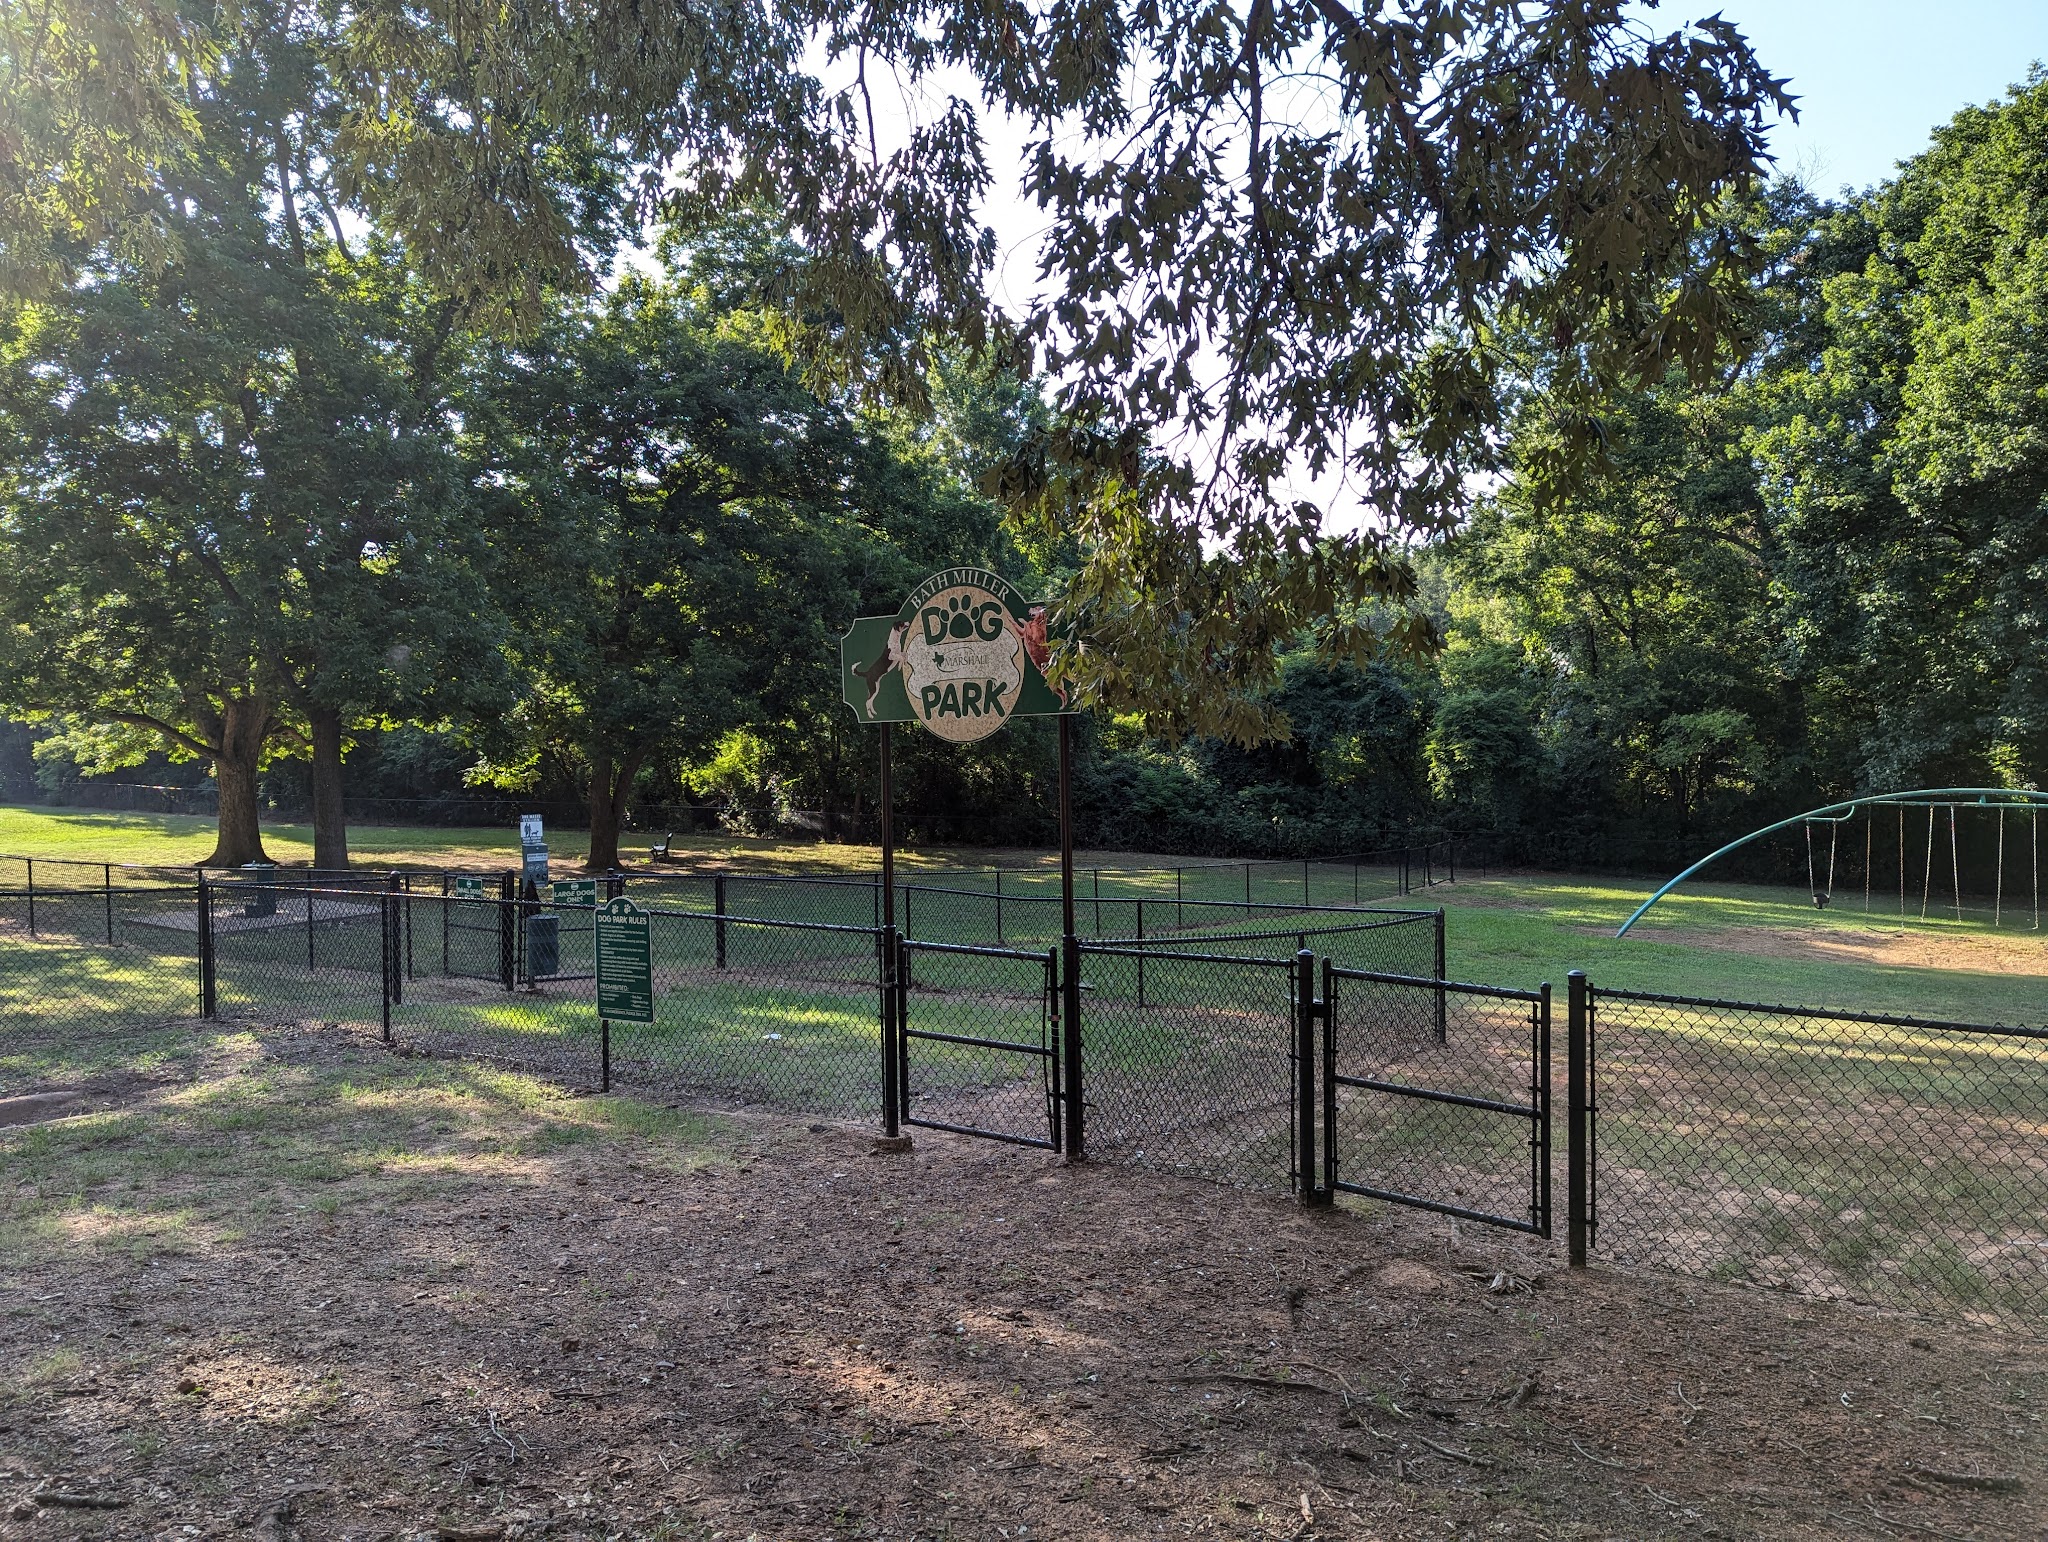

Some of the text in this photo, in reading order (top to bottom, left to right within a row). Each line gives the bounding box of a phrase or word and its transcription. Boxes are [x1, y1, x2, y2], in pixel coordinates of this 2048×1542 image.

[910, 569, 1010, 610] BATH MILLER
[920, 594, 1004, 646] DOG
[944, 655, 989, 667] MARSHALL
[920, 681, 1007, 721] PARK
[554, 889, 595, 898] LARGE DOGS
[612, 916, 628, 924] PARK
[628, 916, 647, 925] RULES
